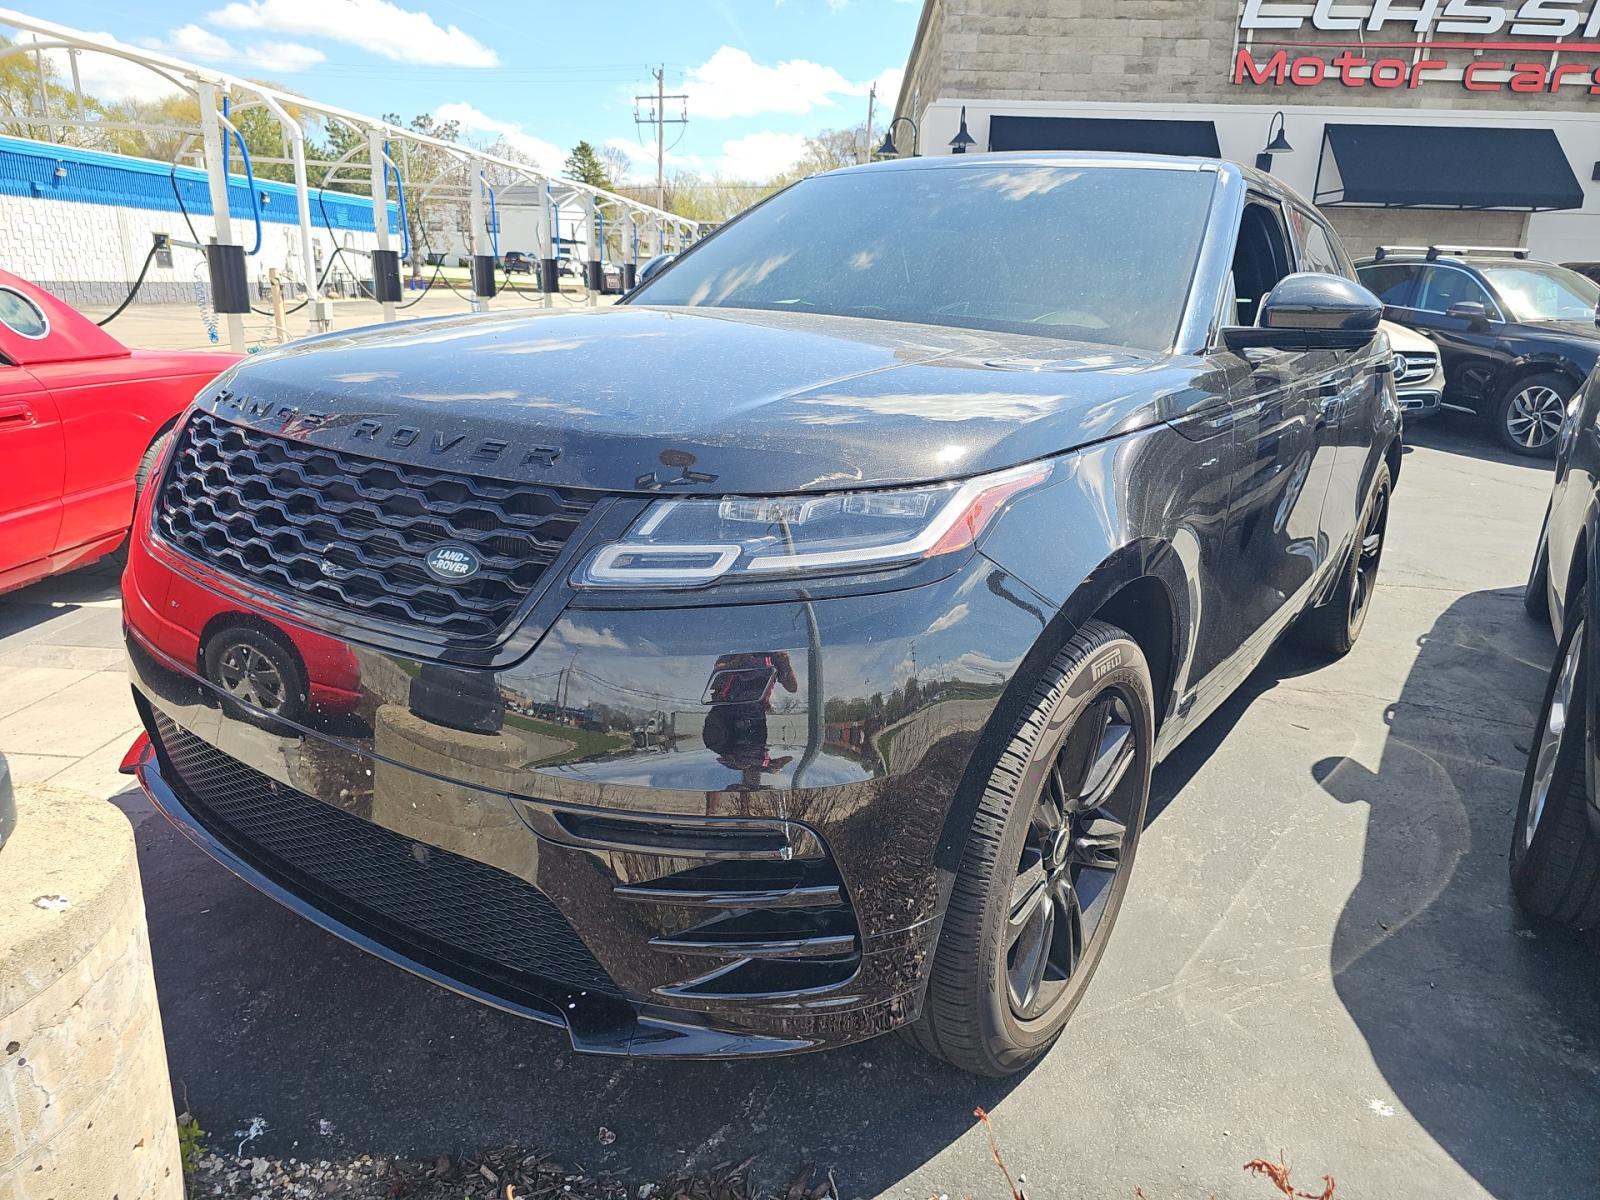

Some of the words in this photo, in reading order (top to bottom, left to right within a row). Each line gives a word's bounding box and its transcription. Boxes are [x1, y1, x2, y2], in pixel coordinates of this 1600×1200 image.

[1234, 48, 1447, 89] Motor
[214, 389, 331, 425] RANGE
[352, 418, 563, 467] ROVER
[436, 549, 464, 562] LAND
[436, 560, 469, 574] ROVER
[1091, 648, 1121, 682] PIRELLI
